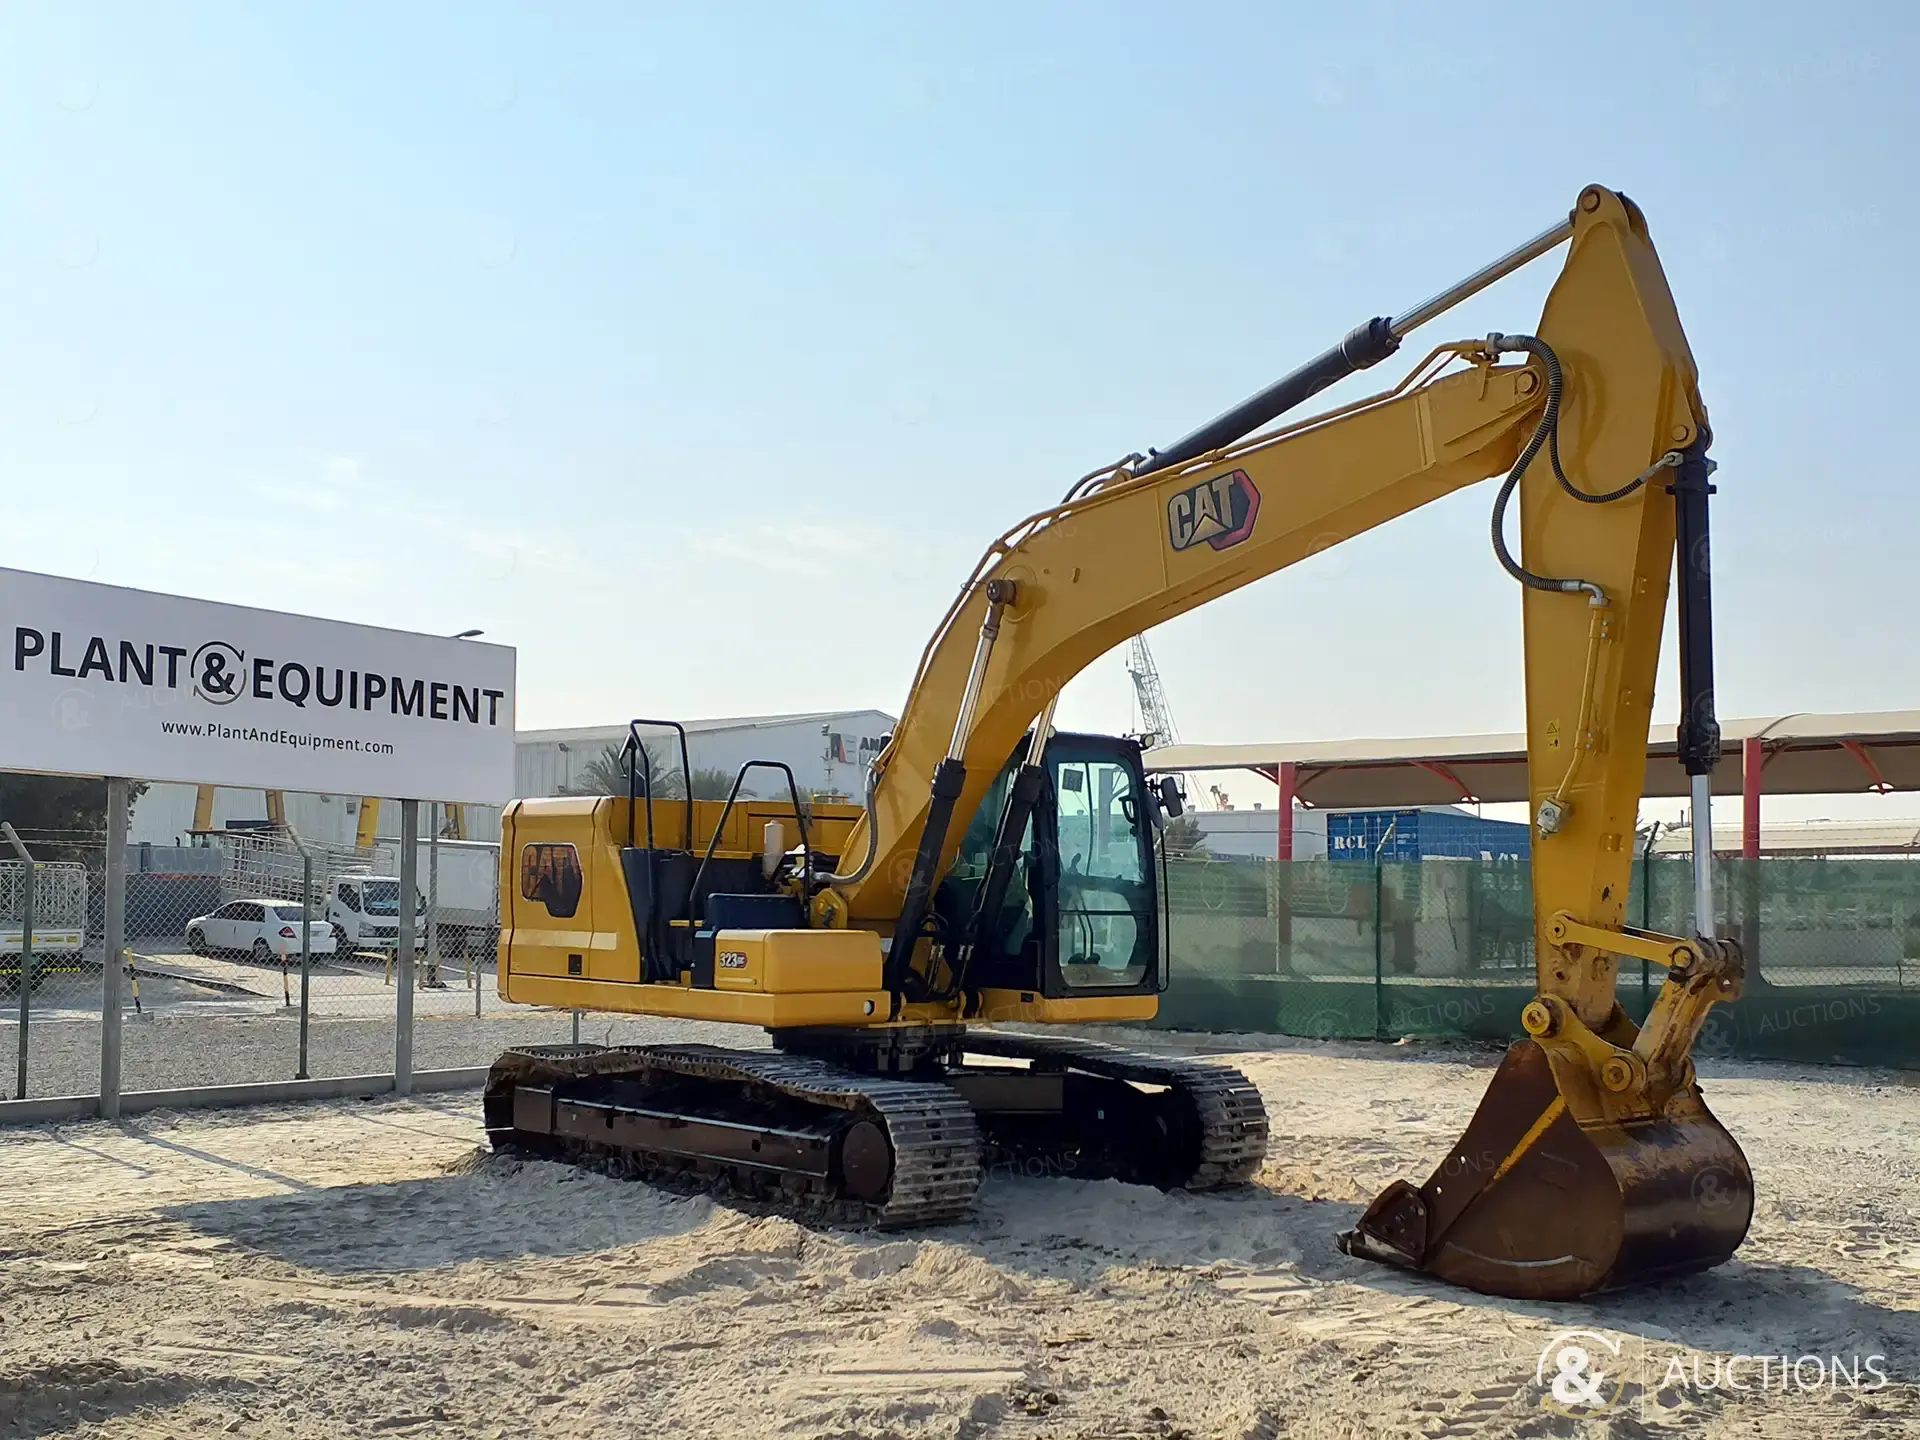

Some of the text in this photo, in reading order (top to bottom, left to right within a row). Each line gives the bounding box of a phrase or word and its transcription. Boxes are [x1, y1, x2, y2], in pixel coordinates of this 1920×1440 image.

[1169, 474, 1234, 549] CAT
[14, 626, 187, 689] PLANT
[252, 657, 504, 727] EQUIPMENT
[161, 719, 395, 756] www.PlantAndEquipment.com
[1334, 836, 1367, 850] RCL
[720, 952, 738, 968] 323
